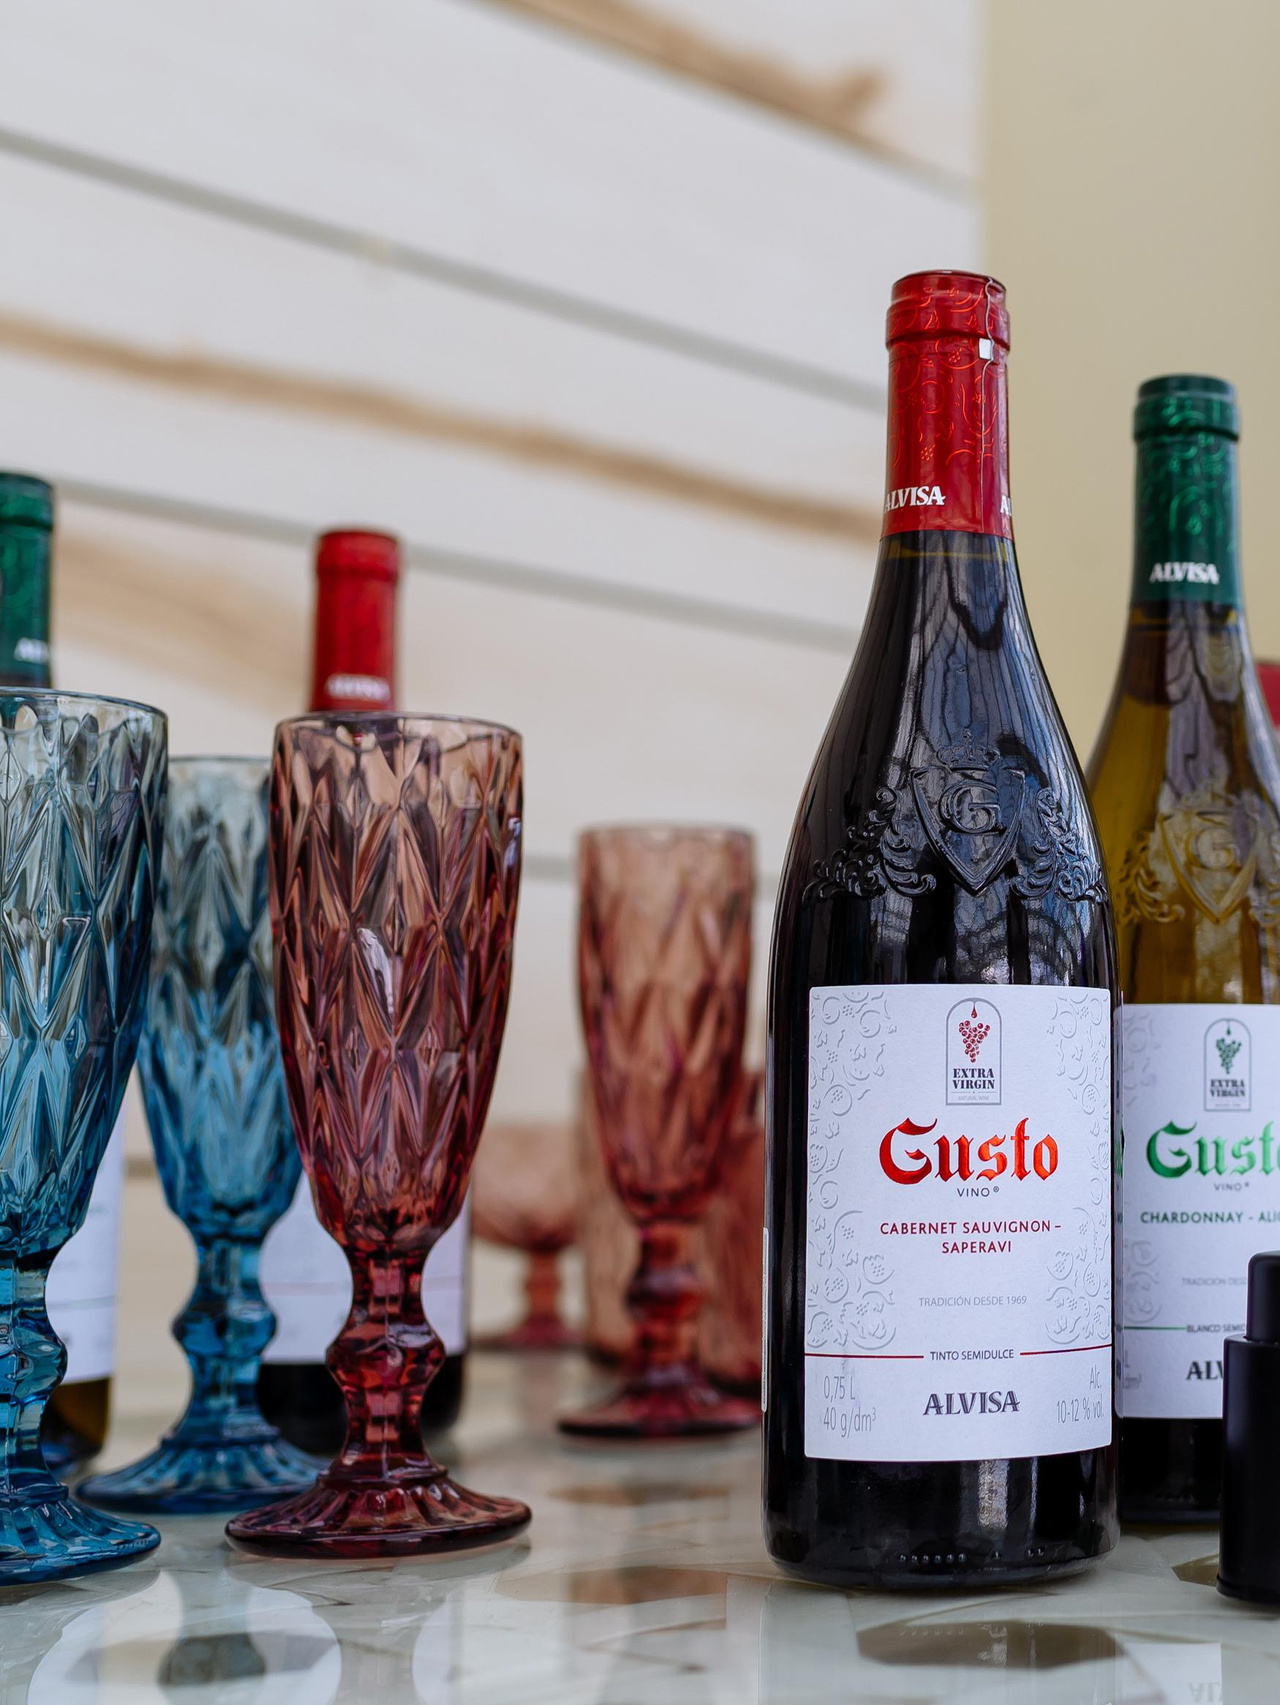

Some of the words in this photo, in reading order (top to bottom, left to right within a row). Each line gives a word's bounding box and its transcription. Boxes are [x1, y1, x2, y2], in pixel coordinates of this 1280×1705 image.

[885, 485, 946, 512] ALVISA
[1149, 562, 1220, 585] ALVISA
[953, 1068, 994, 1078] EXTRA
[952, 1080, 995, 1089] VIRGIN
[1210, 1078, 1245, 1088] EXTRA
[879, 1117, 1059, 1185] Gusto
[1140, 1211, 1243, 1224] CHARDONNAY
[880, 1222, 957, 1235] CABERNET
[942, 1240, 1012, 1253] SAPERAVI
[918, 1295, 970, 1307] TRADICIÓN
[973, 1296, 1004, 1306] DESDE
[1006, 1295, 1027, 1305] 1969
[1186, 1324, 1220, 1333] BLANCO
[930, 1351, 960, 1361] TINTO
[962, 1349, 1014, 1360] SEMIDULCE
[823, 1375, 845, 1403] 0,75
[850, 1375, 856, 1400] L
[922, 1390, 1021, 1416] ALVISA
[1057, 1398, 1080, 1424] 10-12
[823, 1406, 837, 1431] 40
